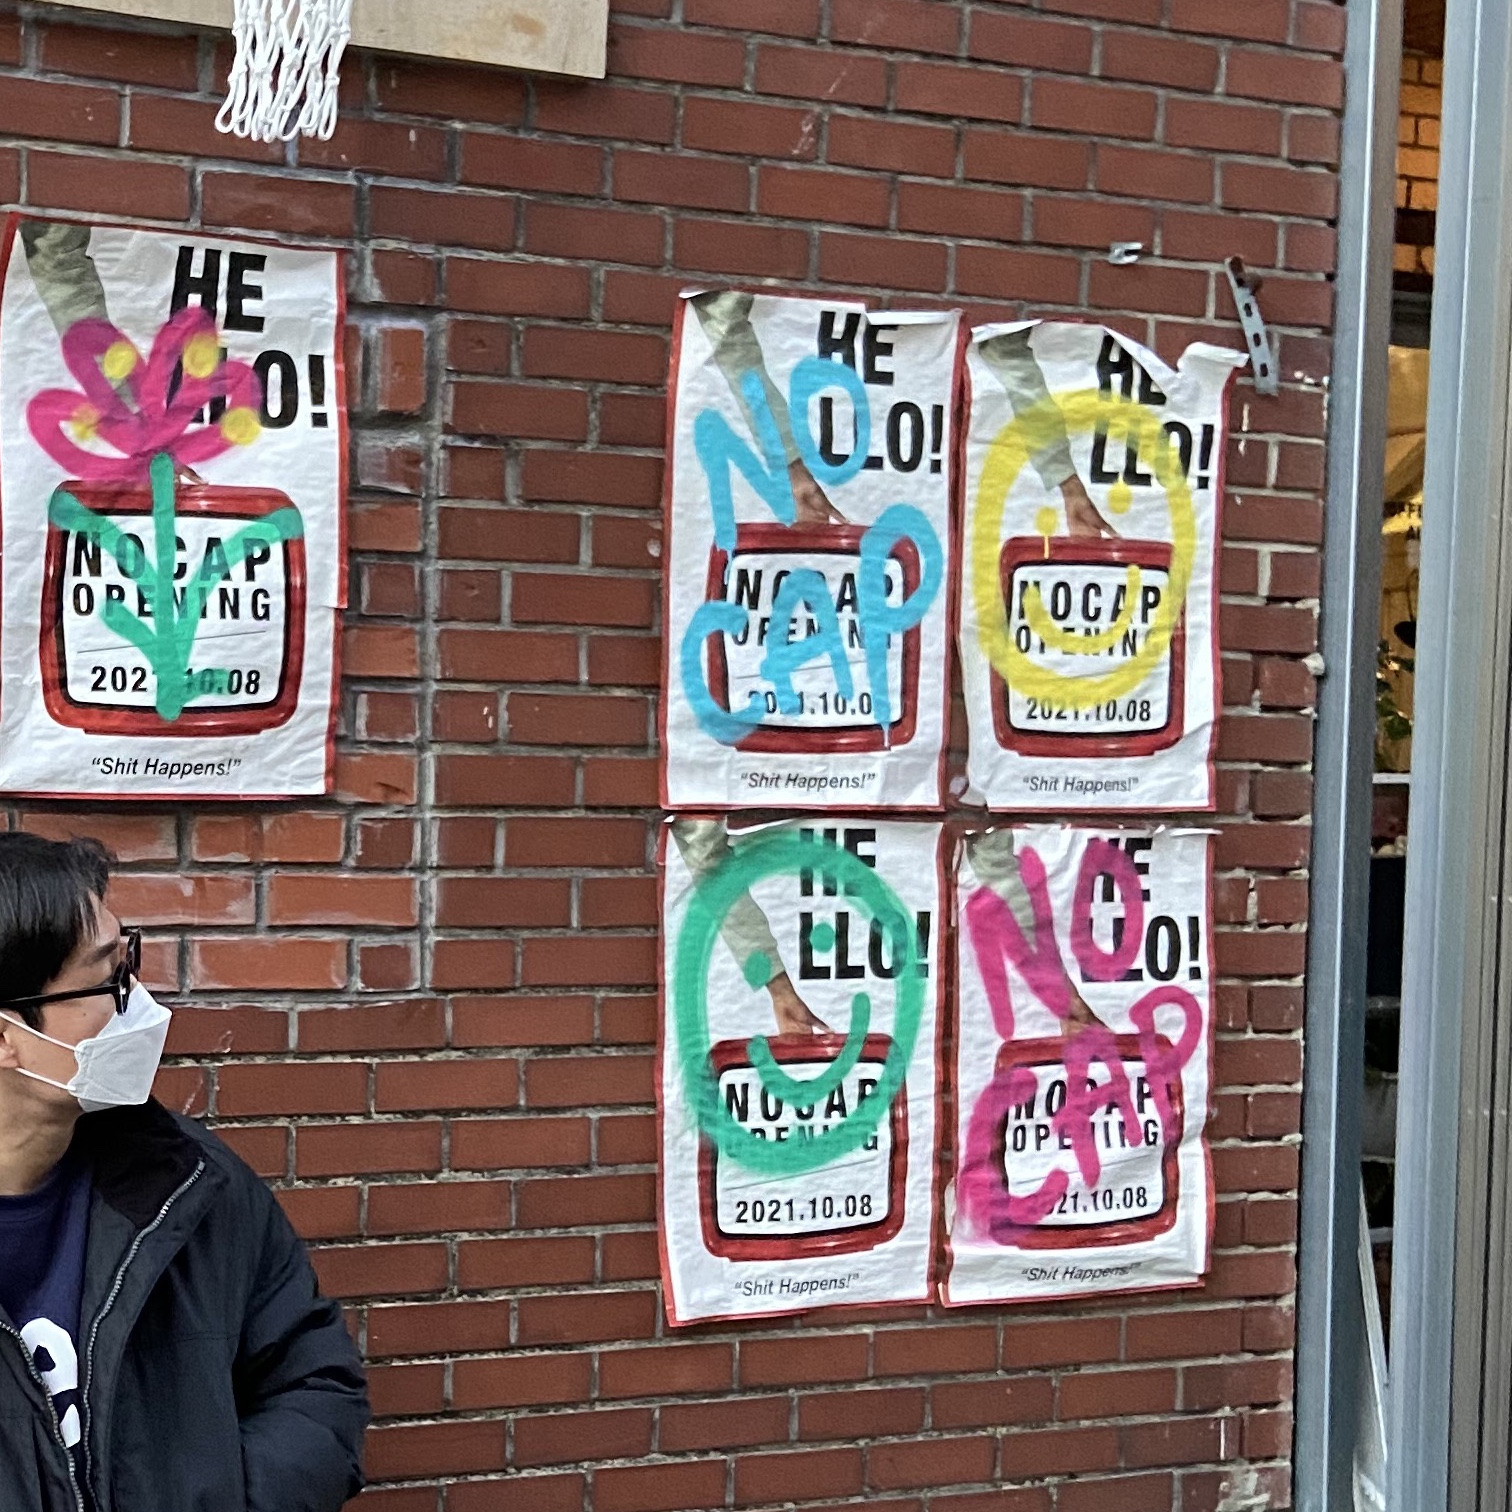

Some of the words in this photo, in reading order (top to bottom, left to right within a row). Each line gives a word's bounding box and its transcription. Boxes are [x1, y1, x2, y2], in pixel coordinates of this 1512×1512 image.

[169, 246, 268, 333] HE
[693, 356, 871, 551] NO
[681, 503, 944, 745] CAP
[965, 836, 1145, 1041] NO
[735, 1194, 873, 1223] 2021.10.08
[960, 985, 1203, 1241] CAP
